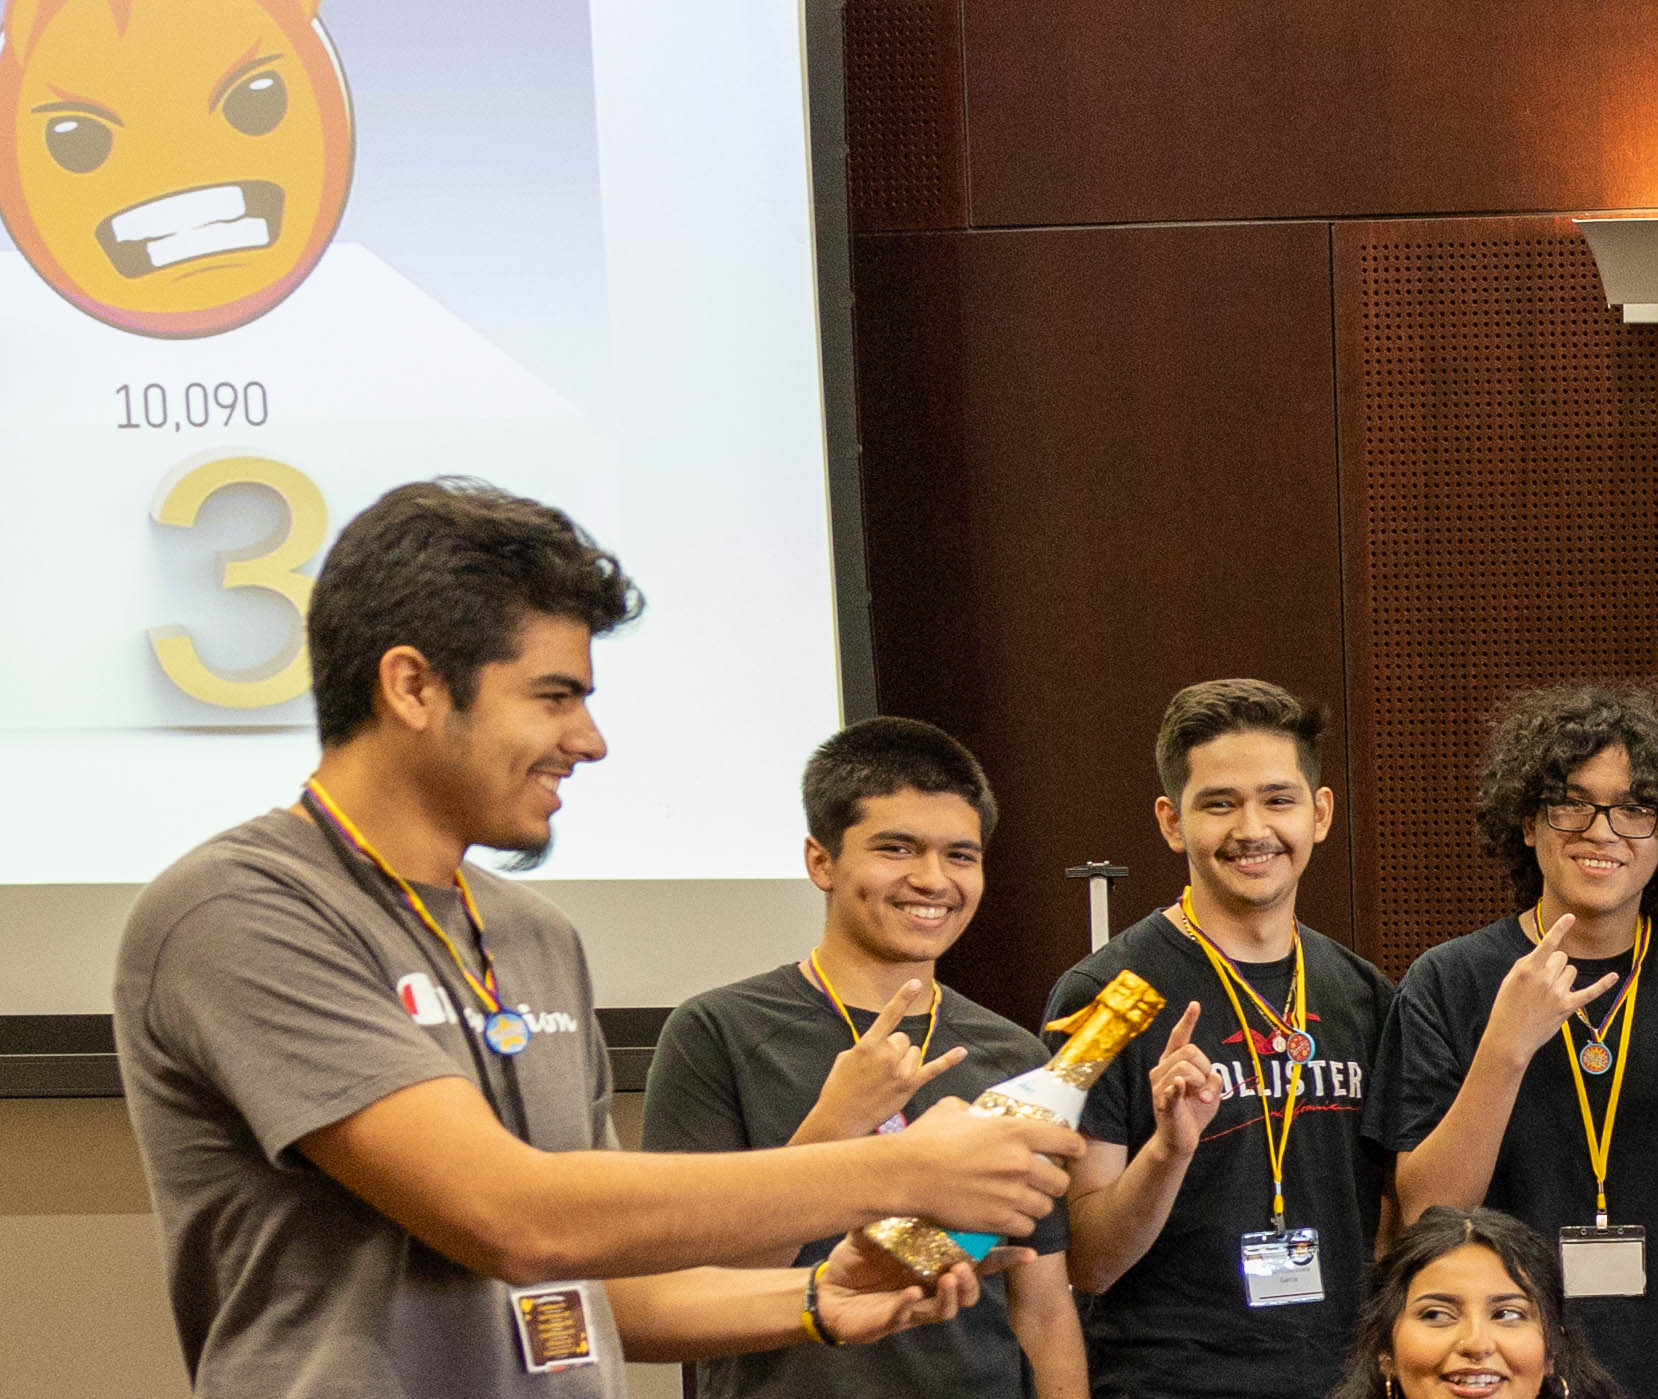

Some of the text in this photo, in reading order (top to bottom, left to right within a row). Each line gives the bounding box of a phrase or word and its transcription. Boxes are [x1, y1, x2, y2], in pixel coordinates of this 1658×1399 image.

[115, 380, 269, 433] 10,090
[148, 450, 328, 710] 3
[1209, 1059, 1363, 1101] OLLISTER
